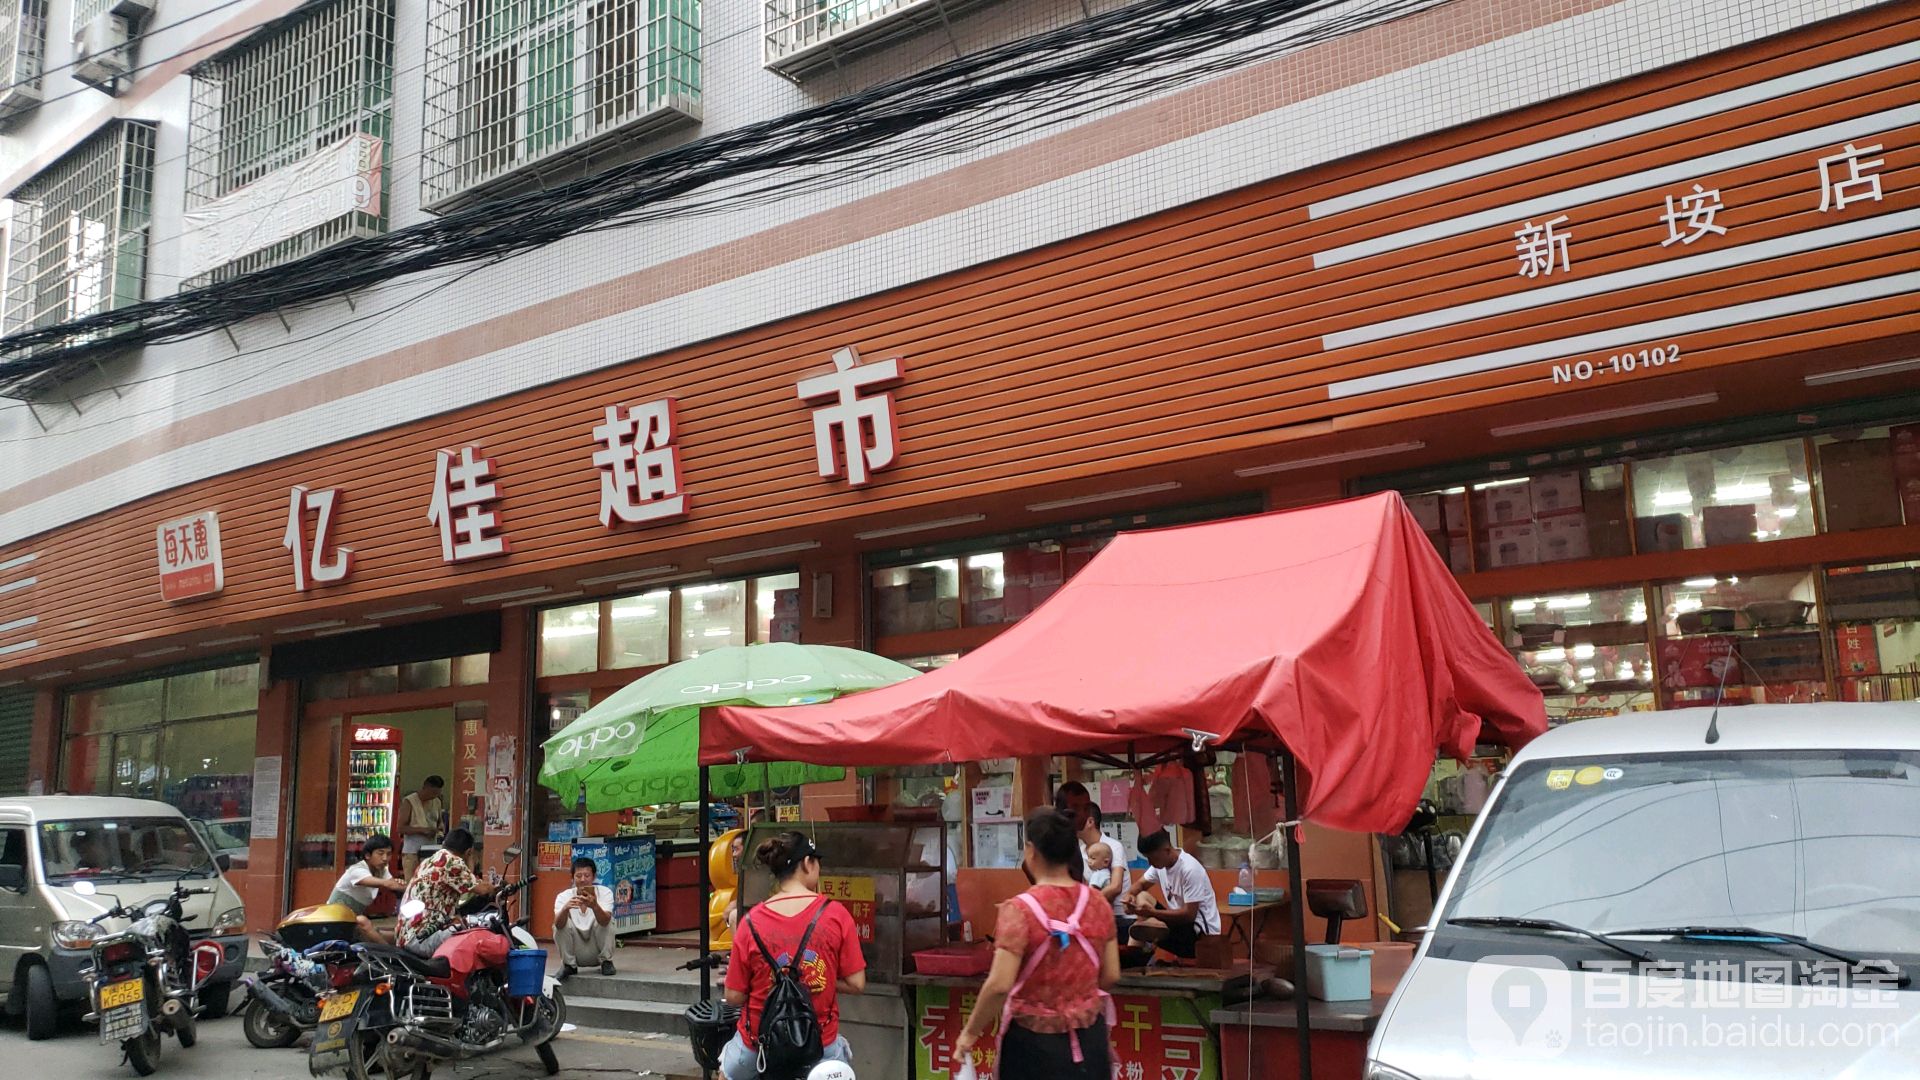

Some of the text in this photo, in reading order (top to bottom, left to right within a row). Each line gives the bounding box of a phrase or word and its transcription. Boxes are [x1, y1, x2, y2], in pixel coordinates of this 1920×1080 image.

[1552, 344, 1681, 384] NO:10102
[282, 346, 904, 592] 亿佳超市
[164, 518, 208, 567] 每天惠
[822, 880, 851, 897] 豆花
[103, 989, 140, 1008] KF065
